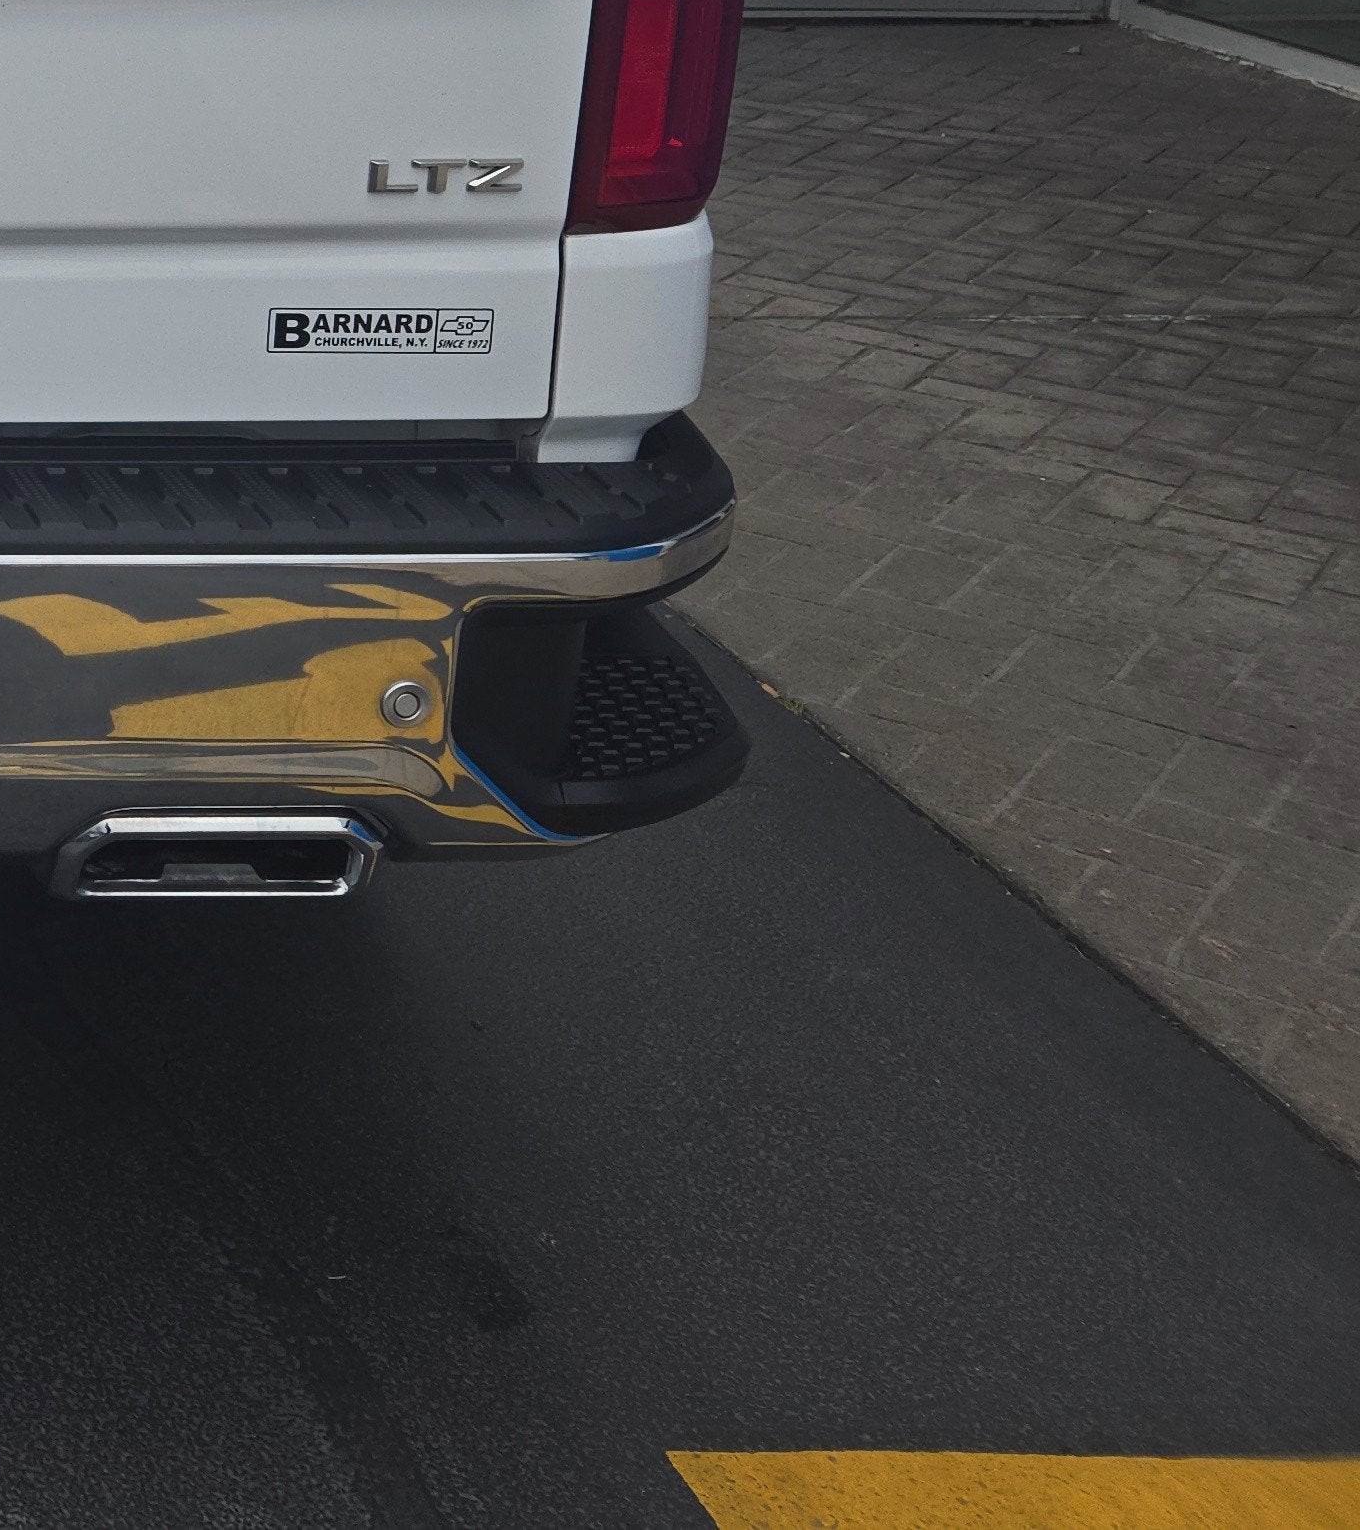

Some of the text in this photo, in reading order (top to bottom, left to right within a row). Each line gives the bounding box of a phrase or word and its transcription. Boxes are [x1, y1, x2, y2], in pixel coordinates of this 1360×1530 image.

[366, 157, 525, 194] LTZ
[273, 312, 434, 349] BARNARD
[314, 337, 428, 349] CHURCHVILLE, N.Y.
[437, 339, 489, 349] SINCE 1972
